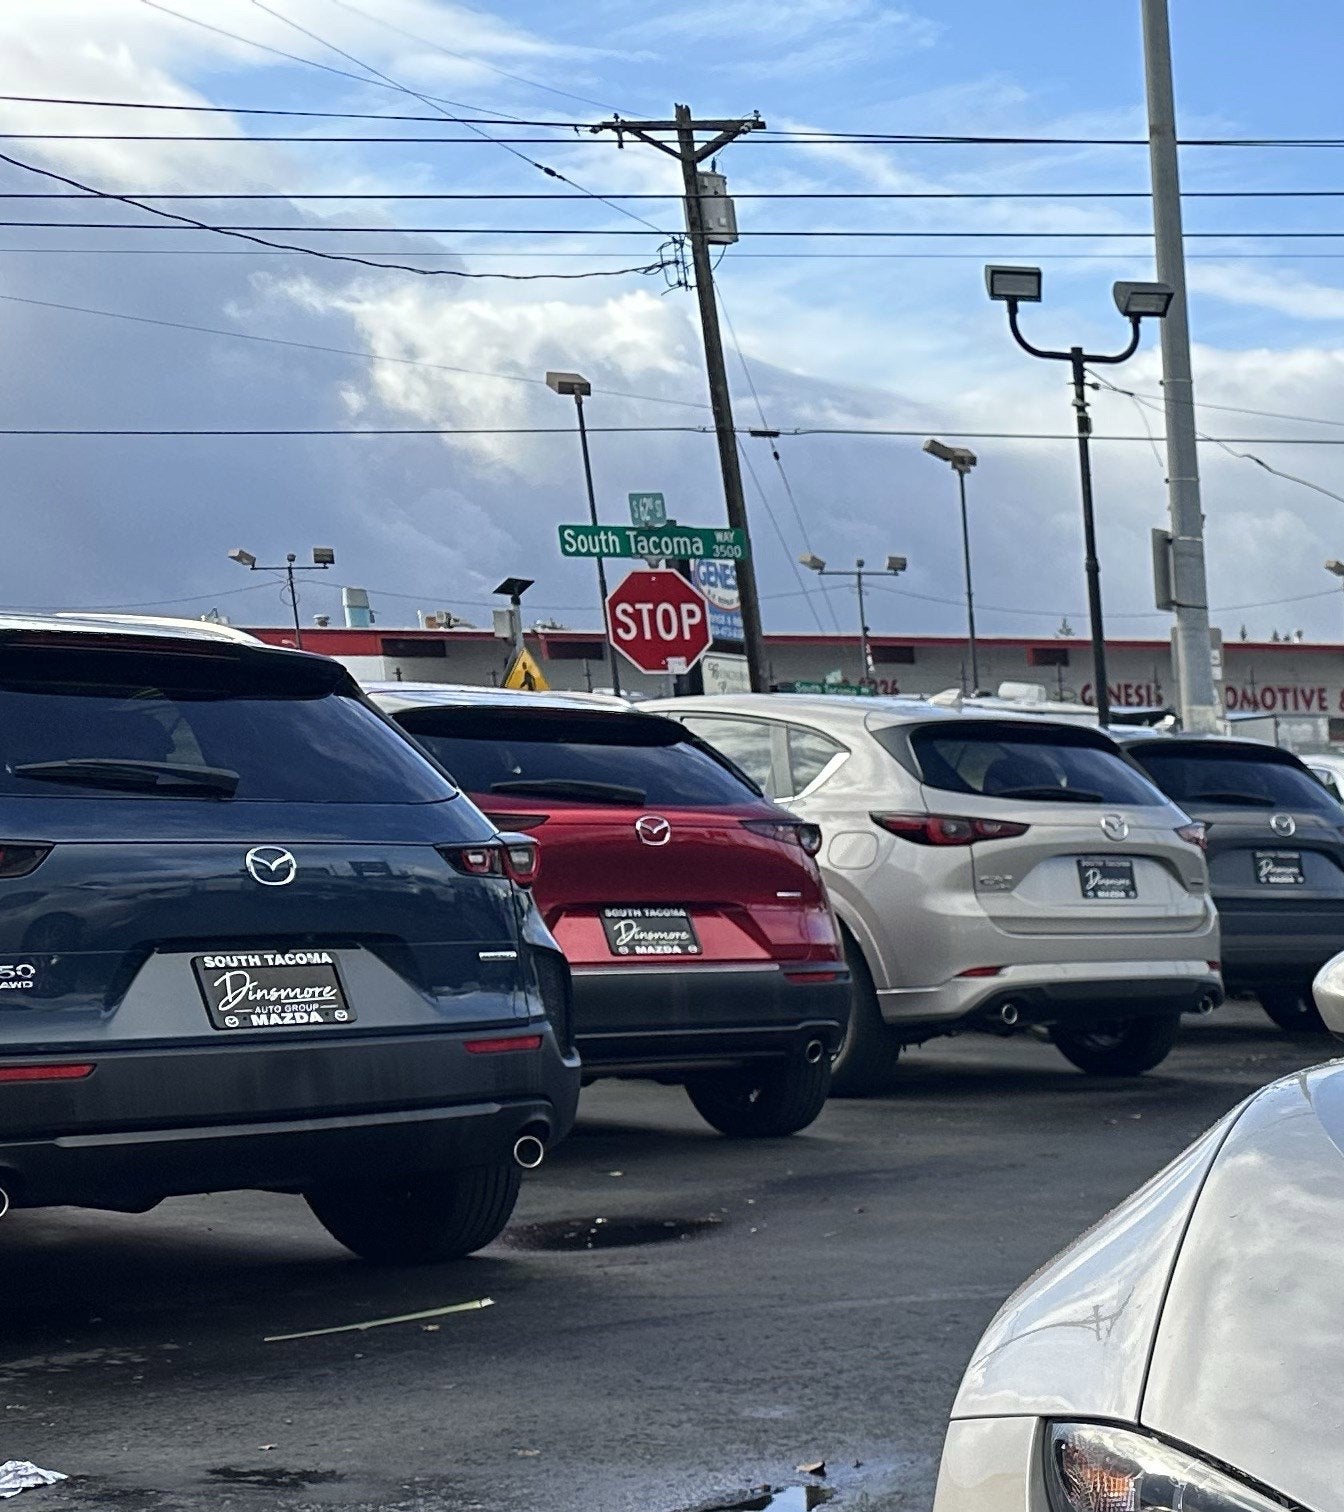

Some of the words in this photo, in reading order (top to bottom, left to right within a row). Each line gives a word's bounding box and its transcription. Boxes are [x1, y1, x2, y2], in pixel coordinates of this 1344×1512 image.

[563, 529, 621, 554] South
[626, 531, 704, 555] Tacoma
[713, 531, 735, 543] WAY
[712, 545, 742, 558] 3500
[614, 602, 702, 642] STOP
[1080, 683, 1164, 706] GNESIS
[1225, 686, 1328, 712] OMOTIVE
[613, 919, 690, 946] Dinsmore
[635, 945, 681, 954] MAZDA
[203, 955, 261, 968] SOUTH
[264, 952, 333, 966] TACOMA
[213, 970, 338, 1011] Dinsmore
[255, 1005, 282, 1014] AUTO
[284, 1003, 319, 1012] GROUP
[250, 1012, 324, 1026] MAZDA
